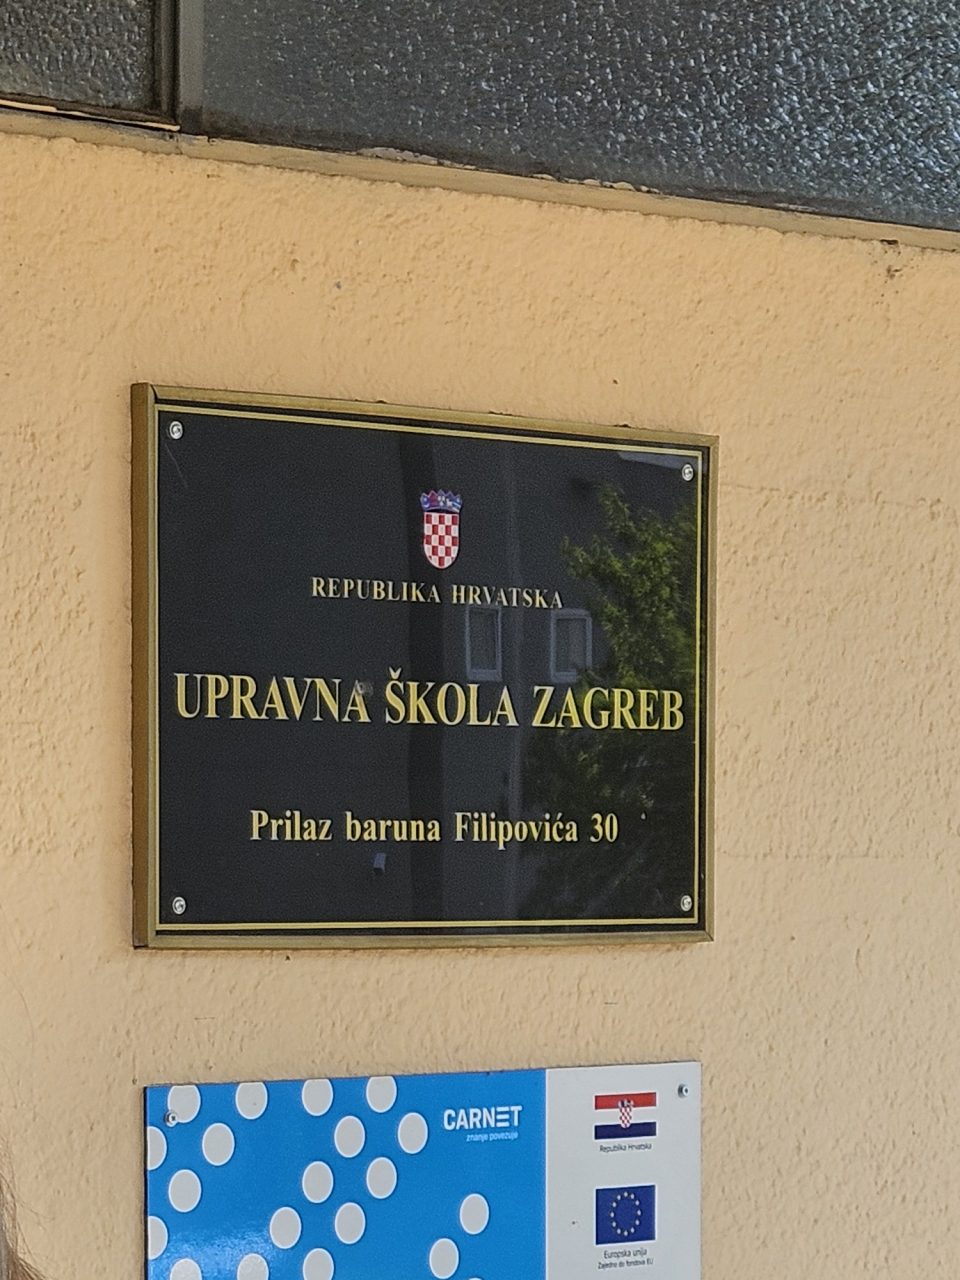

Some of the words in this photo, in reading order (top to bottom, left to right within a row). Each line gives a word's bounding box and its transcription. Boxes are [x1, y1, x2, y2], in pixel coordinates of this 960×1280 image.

[311, 576, 441, 603] REPUBLIKA
[451, 584, 564, 609] HRVATSKA
[174, 672, 371, 723] UPRAVNA
[385, 667, 519, 727] ŠKOLA
[532, 684, 685, 731] ZAGREB
[249, 809, 333, 842] Prilaz
[345, 810, 441, 843] baruna
[454, 810, 578, 851] Filipovića
[589, 812, 619, 843] 30
[443, 1105, 523, 1131] CARNET
[603, 1249, 632, 1259] Europska
